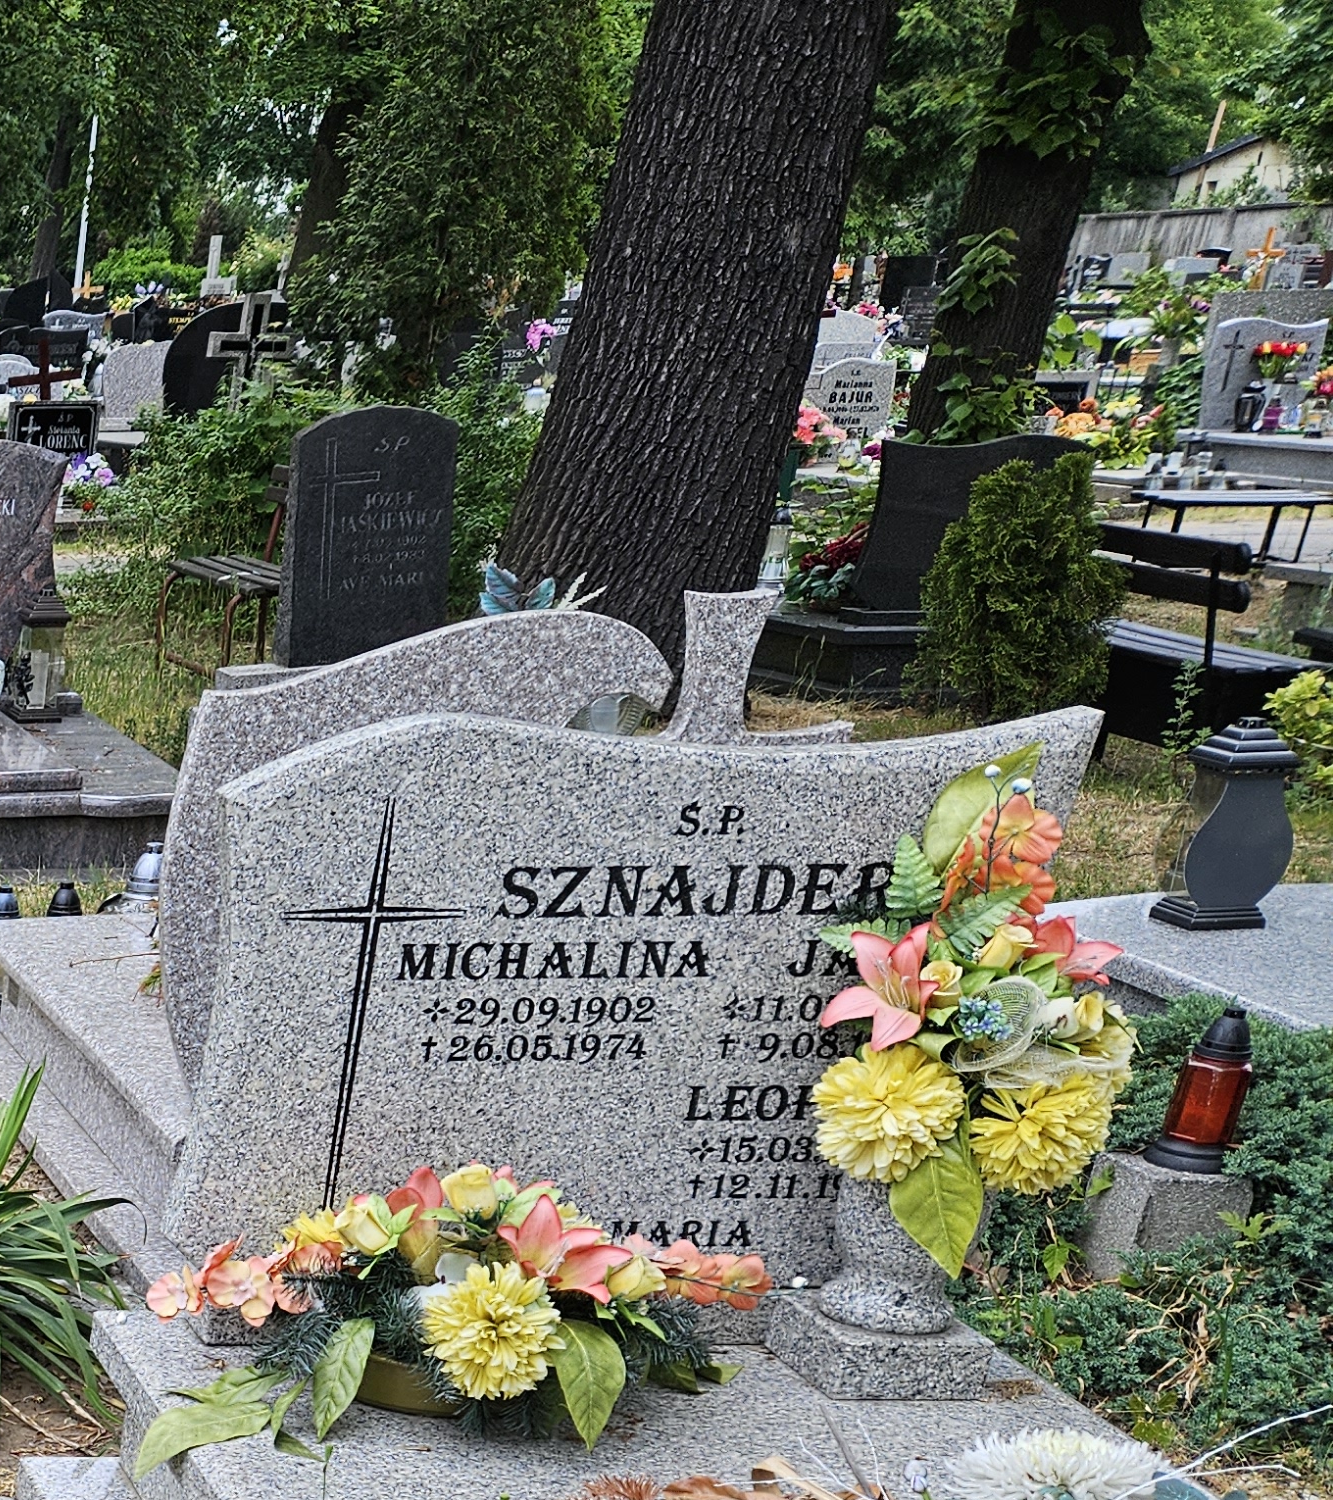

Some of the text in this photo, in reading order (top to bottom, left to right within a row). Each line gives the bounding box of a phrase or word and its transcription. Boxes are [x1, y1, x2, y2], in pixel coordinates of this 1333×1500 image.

[829, 391, 873, 403] BAJUR
[40, 434, 87, 449] LORENC
[396, 940, 710, 981] MICHALINA
